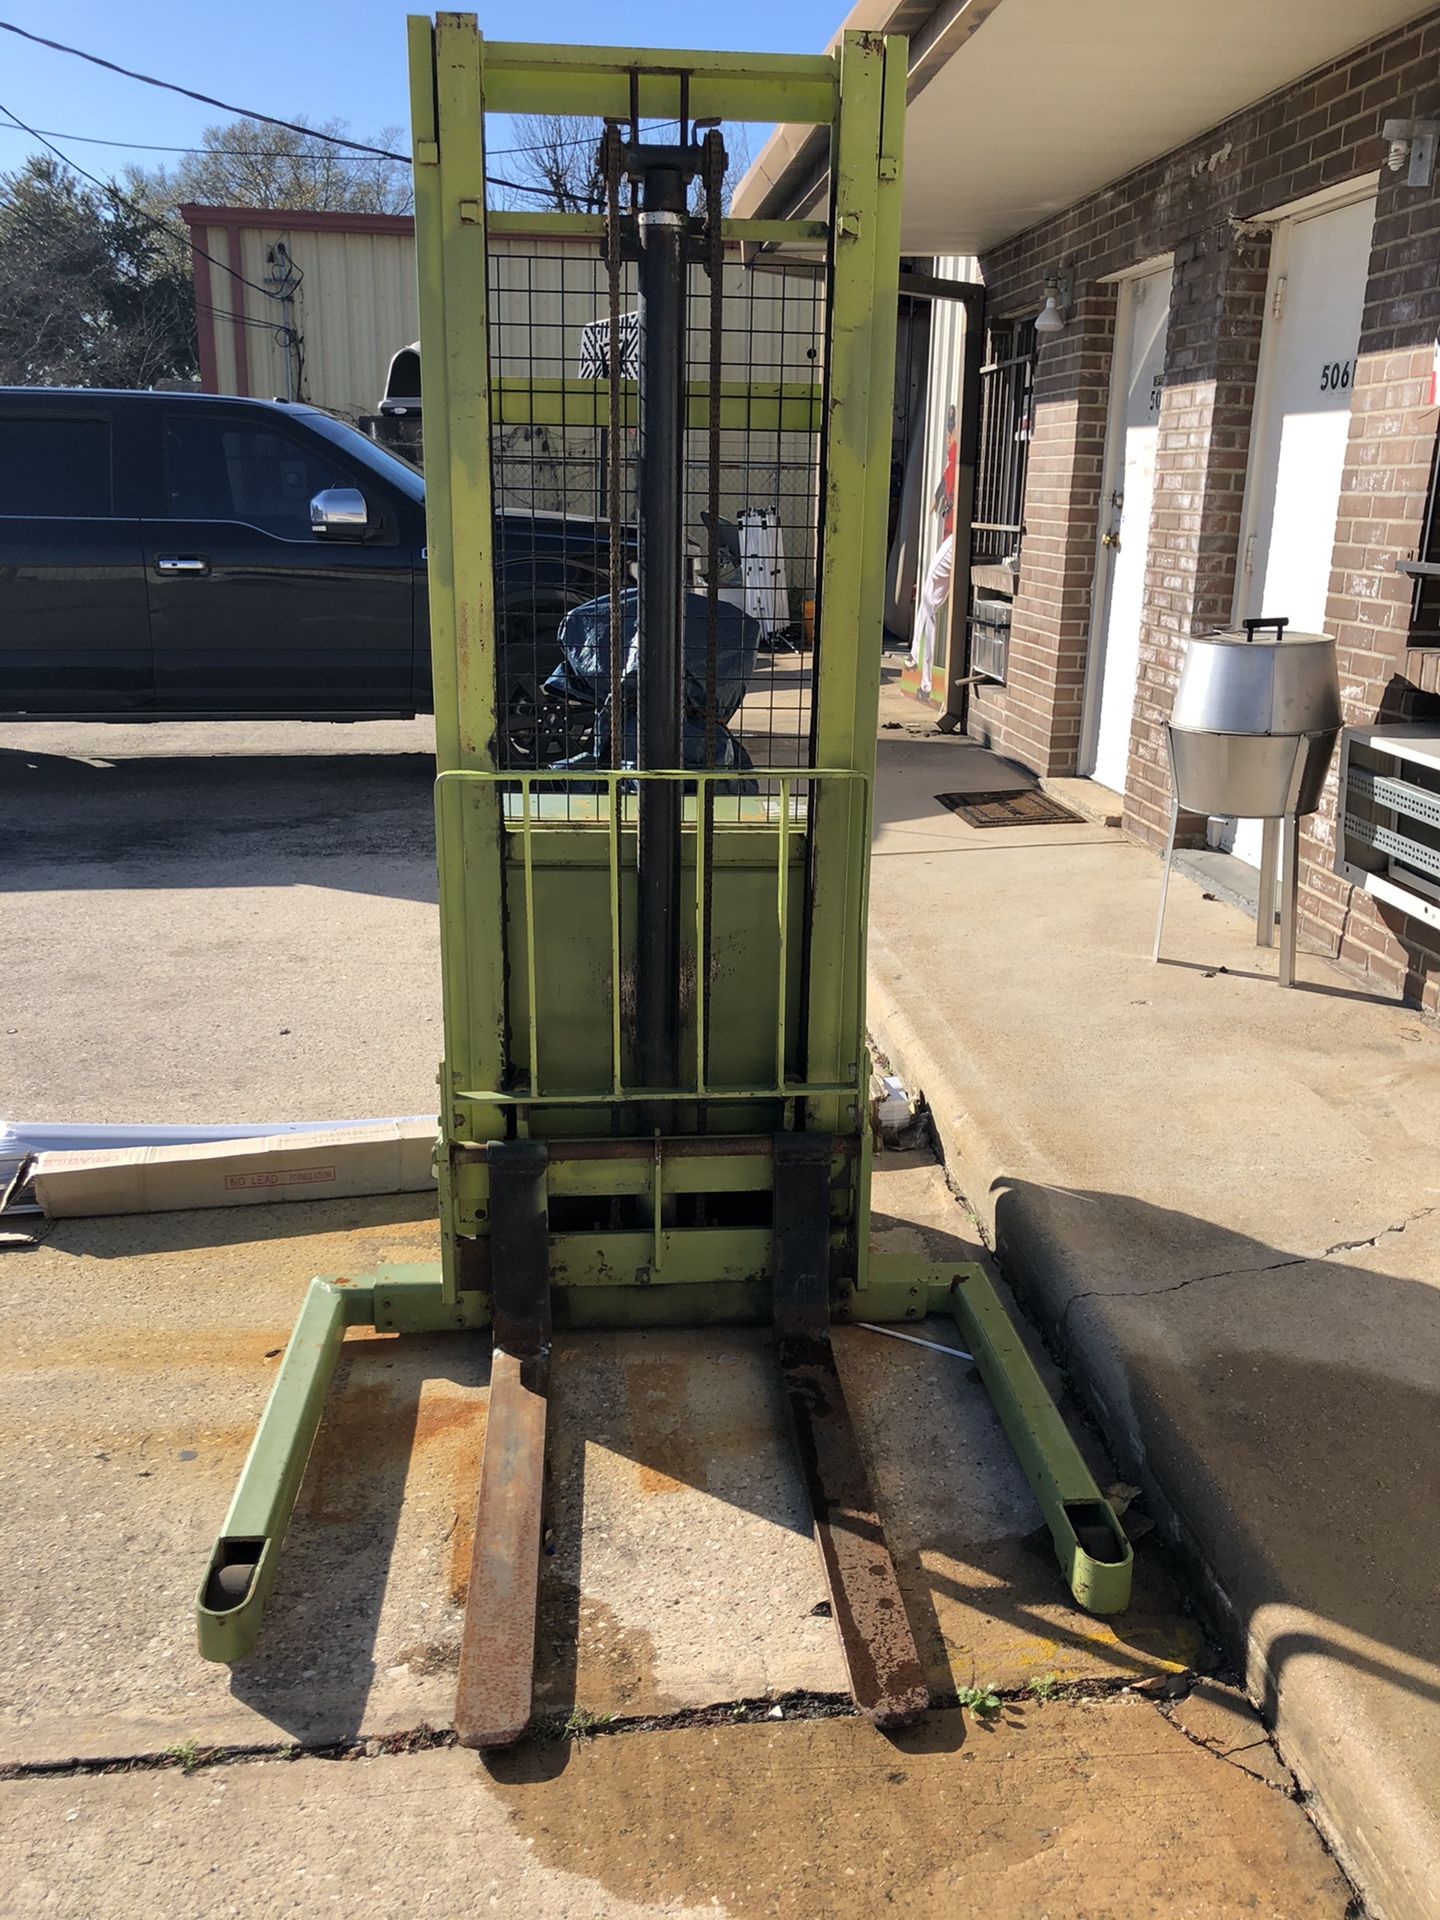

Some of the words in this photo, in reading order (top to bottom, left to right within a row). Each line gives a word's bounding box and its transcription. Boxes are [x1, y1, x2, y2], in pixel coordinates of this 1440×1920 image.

[1320, 359, 1357, 390] 506
[229, 1176, 246, 1187] NO
[251, 1174, 279, 1185] LEAD
